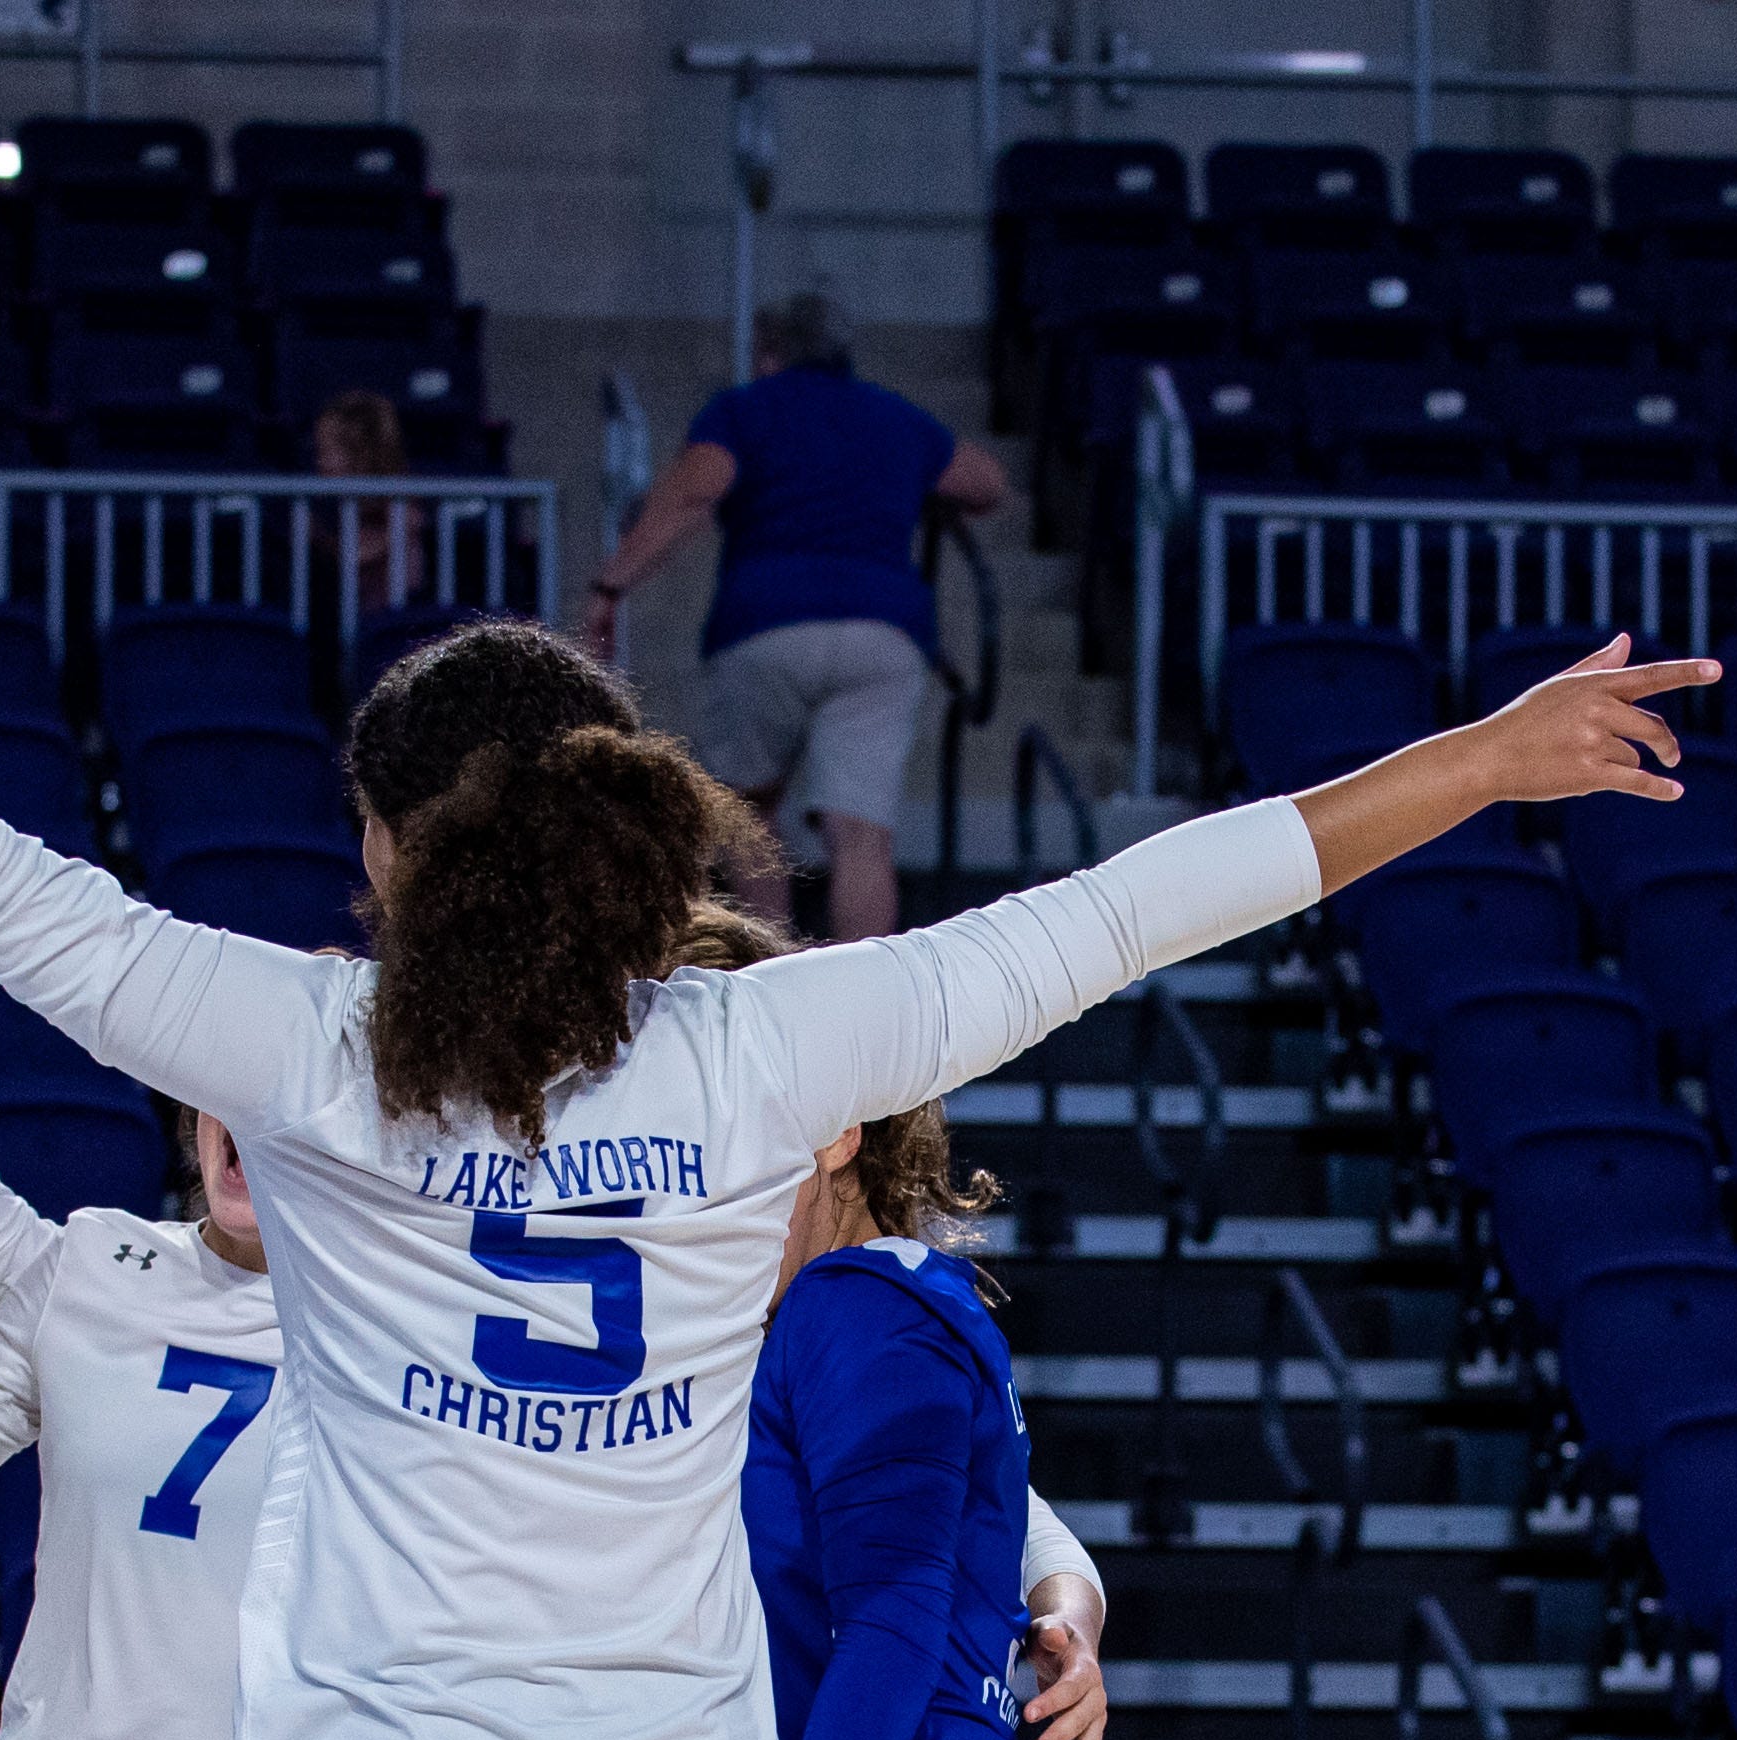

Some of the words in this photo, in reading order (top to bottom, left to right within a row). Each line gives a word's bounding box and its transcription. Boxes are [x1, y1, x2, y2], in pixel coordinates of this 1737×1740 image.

[418, 1151, 533, 1210] LAKE
[538, 1136, 708, 1200] WORTH
[470, 1197, 647, 1396] 5
[139, 1345, 277, 1540] 7
[402, 1363, 695, 1453] CHRISTIAN
